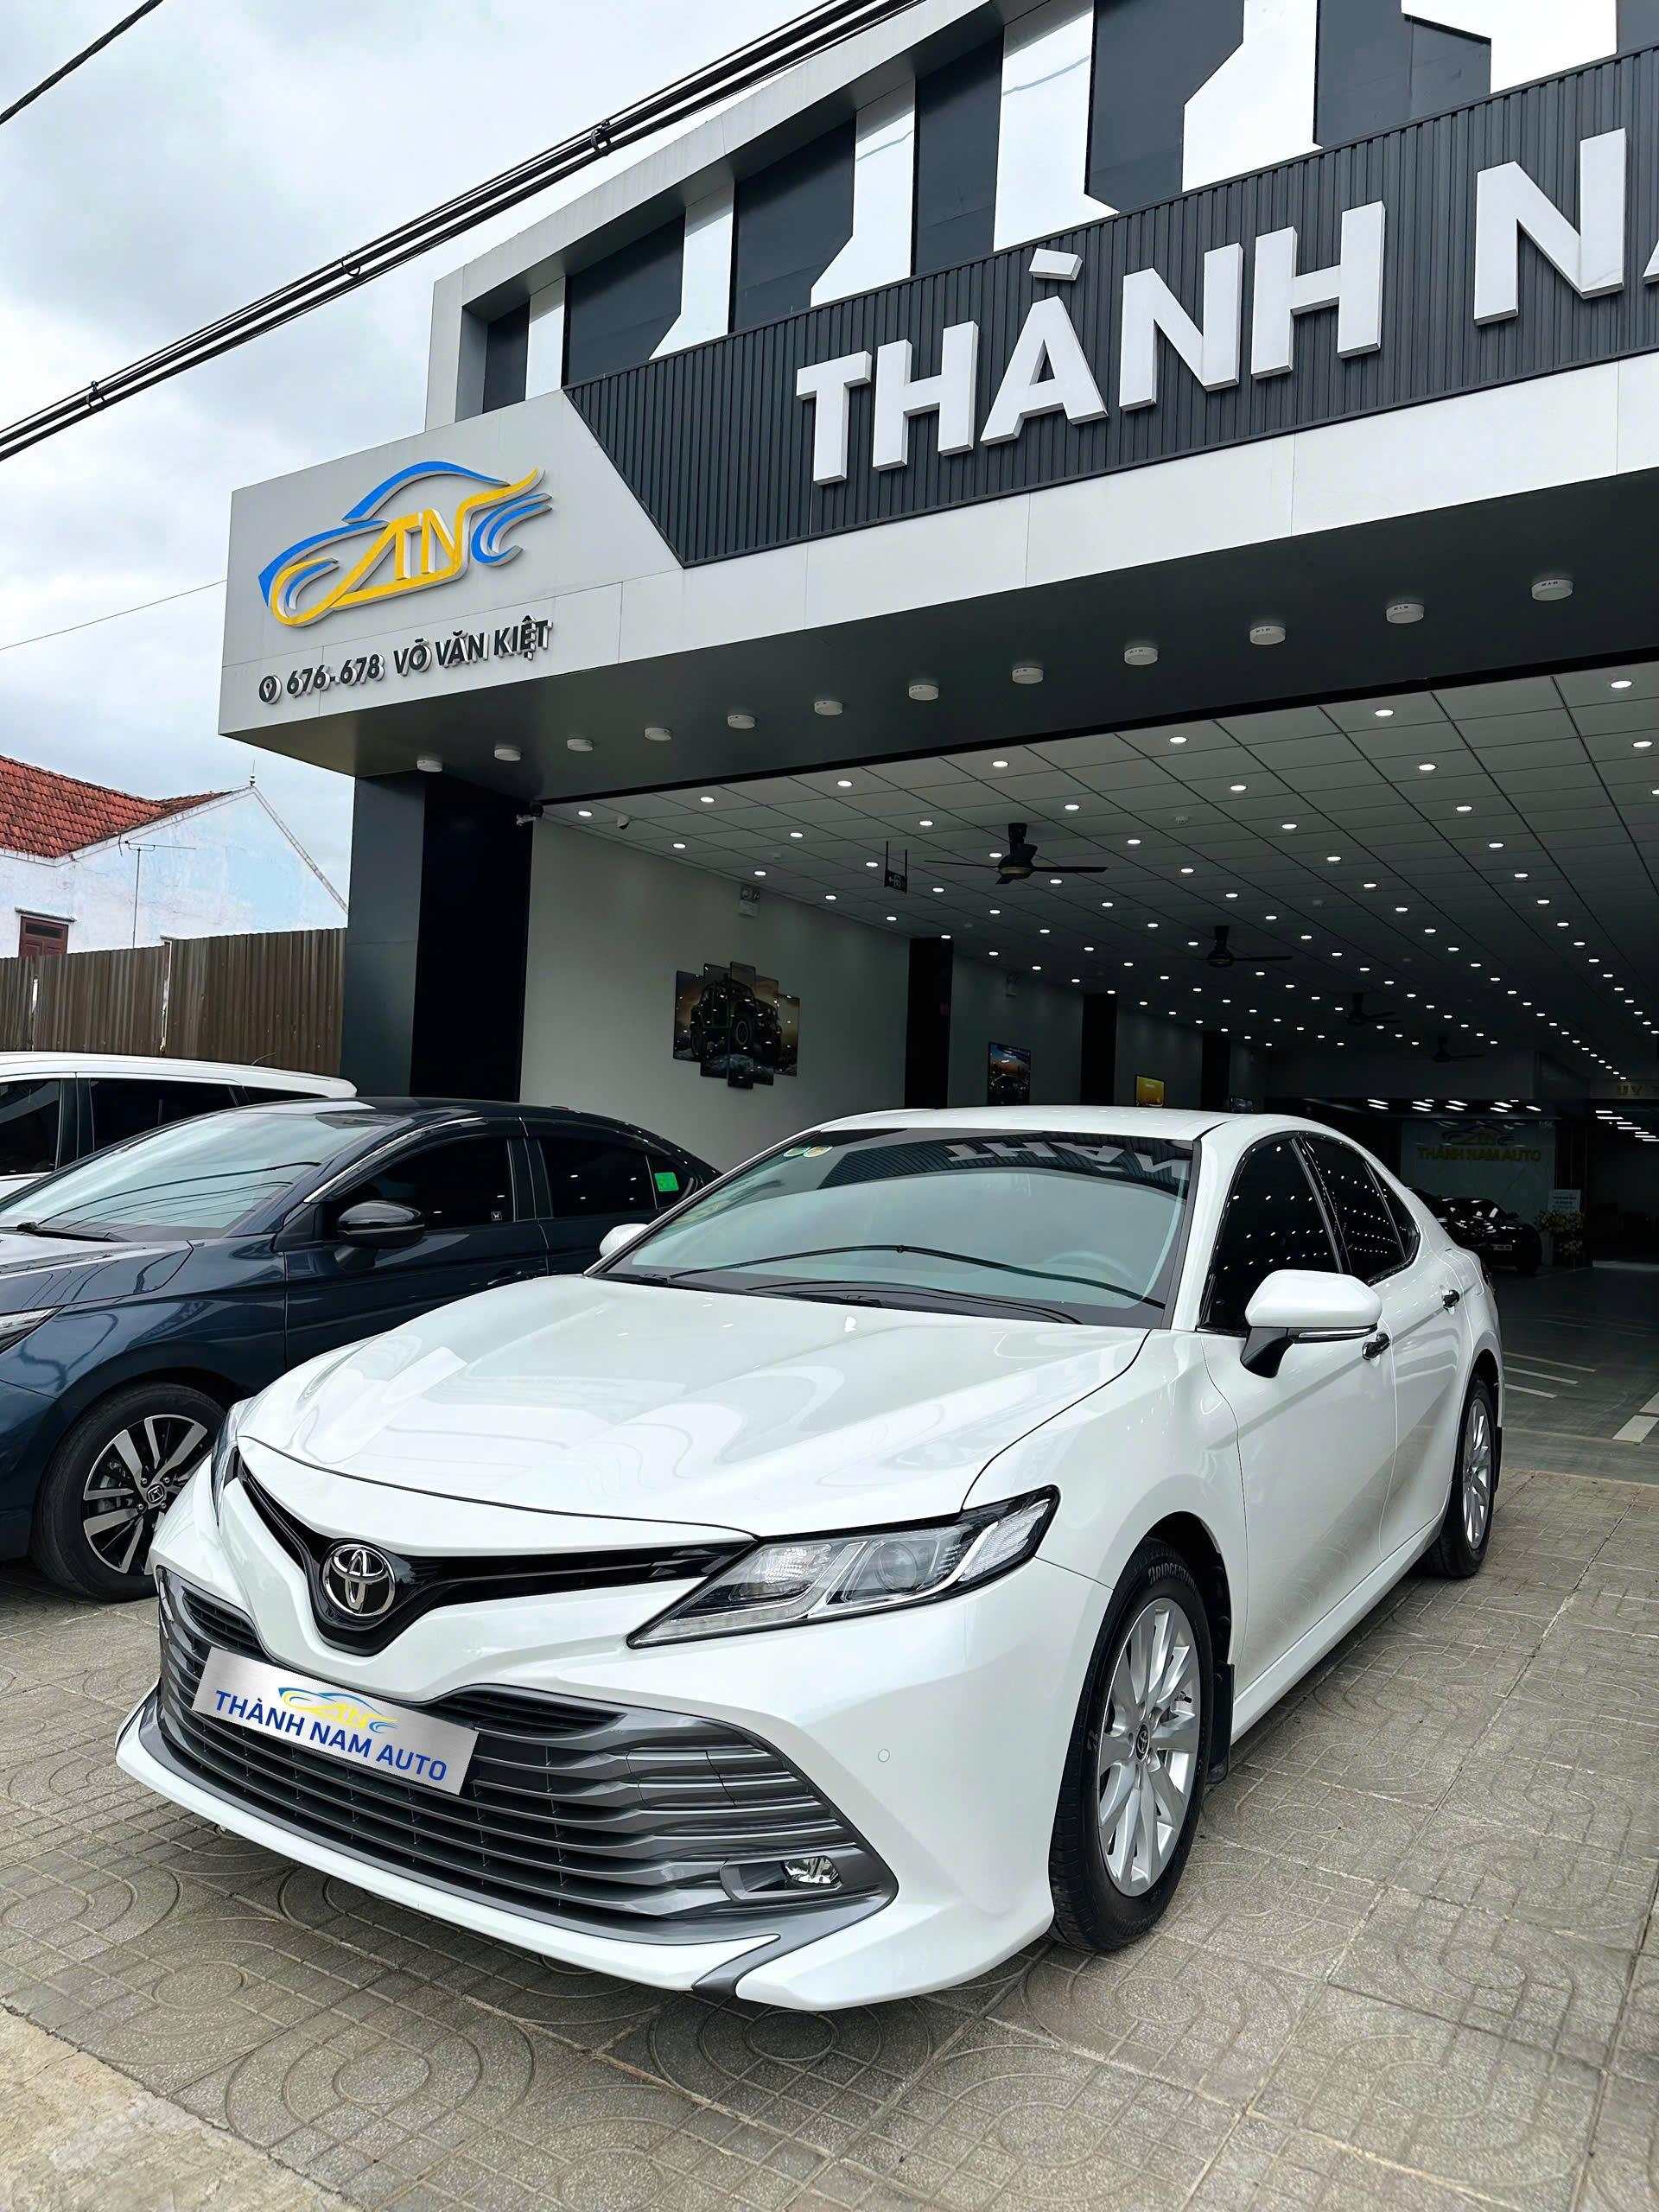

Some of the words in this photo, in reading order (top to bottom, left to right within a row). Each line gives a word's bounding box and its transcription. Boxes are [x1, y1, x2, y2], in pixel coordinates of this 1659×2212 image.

[796, 200, 1386, 486] THÀNH
[1473, 128, 1659, 326] N
[286, 652, 385, 698] 676-678
[393, 638, 432, 677] VÕ
[435, 630, 489, 668] VĂN
[493, 614, 553, 661] KIỆT
[1147, 1562, 1198, 1592] BRIDGESTON
[215, 1689, 306, 1737] THÀNH
[309, 1720, 373, 1758] NAM
[376, 1744, 448, 1782] AUTO
